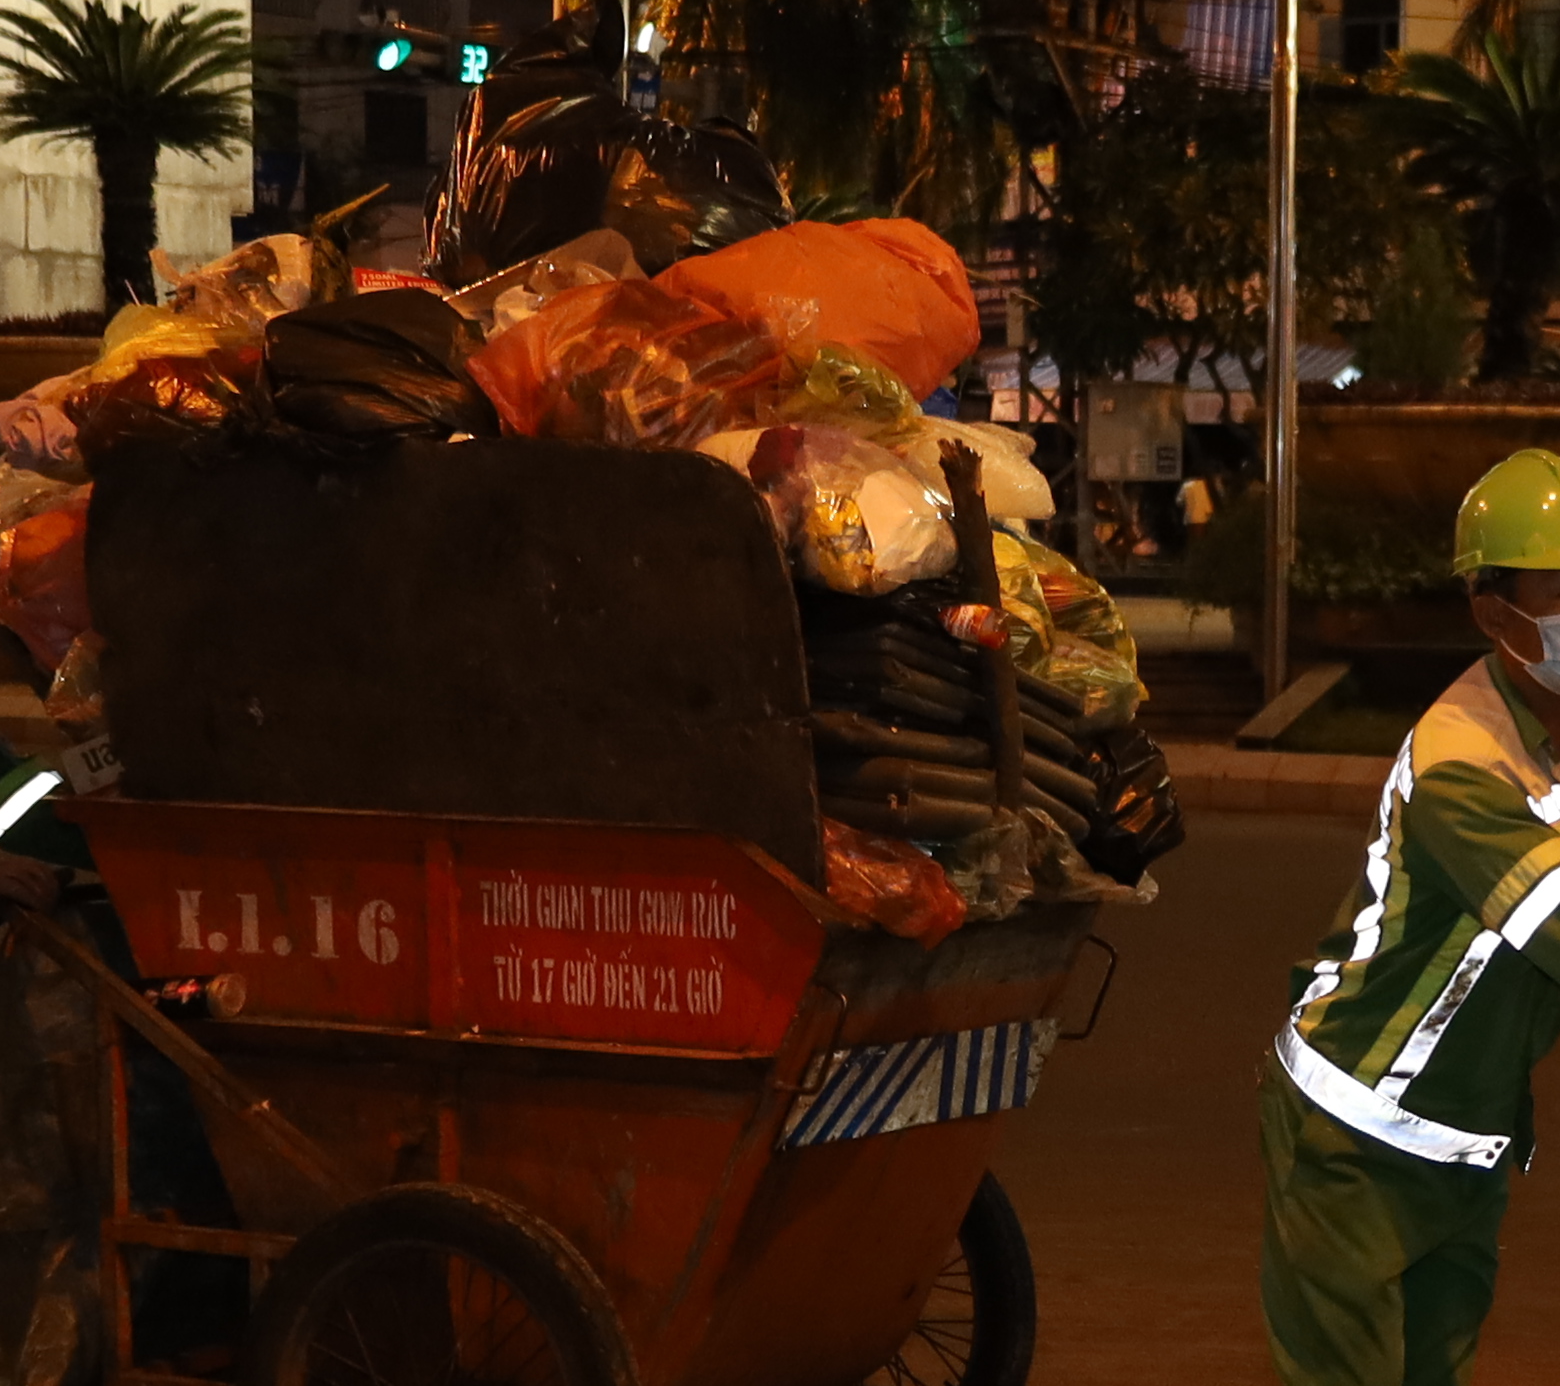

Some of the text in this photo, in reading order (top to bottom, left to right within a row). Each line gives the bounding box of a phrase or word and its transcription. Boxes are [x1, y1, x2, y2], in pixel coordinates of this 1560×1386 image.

[461, 44, 488, 84] 32
[479, 869, 737, 941] THỜI GIAN THU GOM RÁC
[493, 942, 724, 1016] TỪ 17 GIỜ ĐẾN 21 GIỜ
